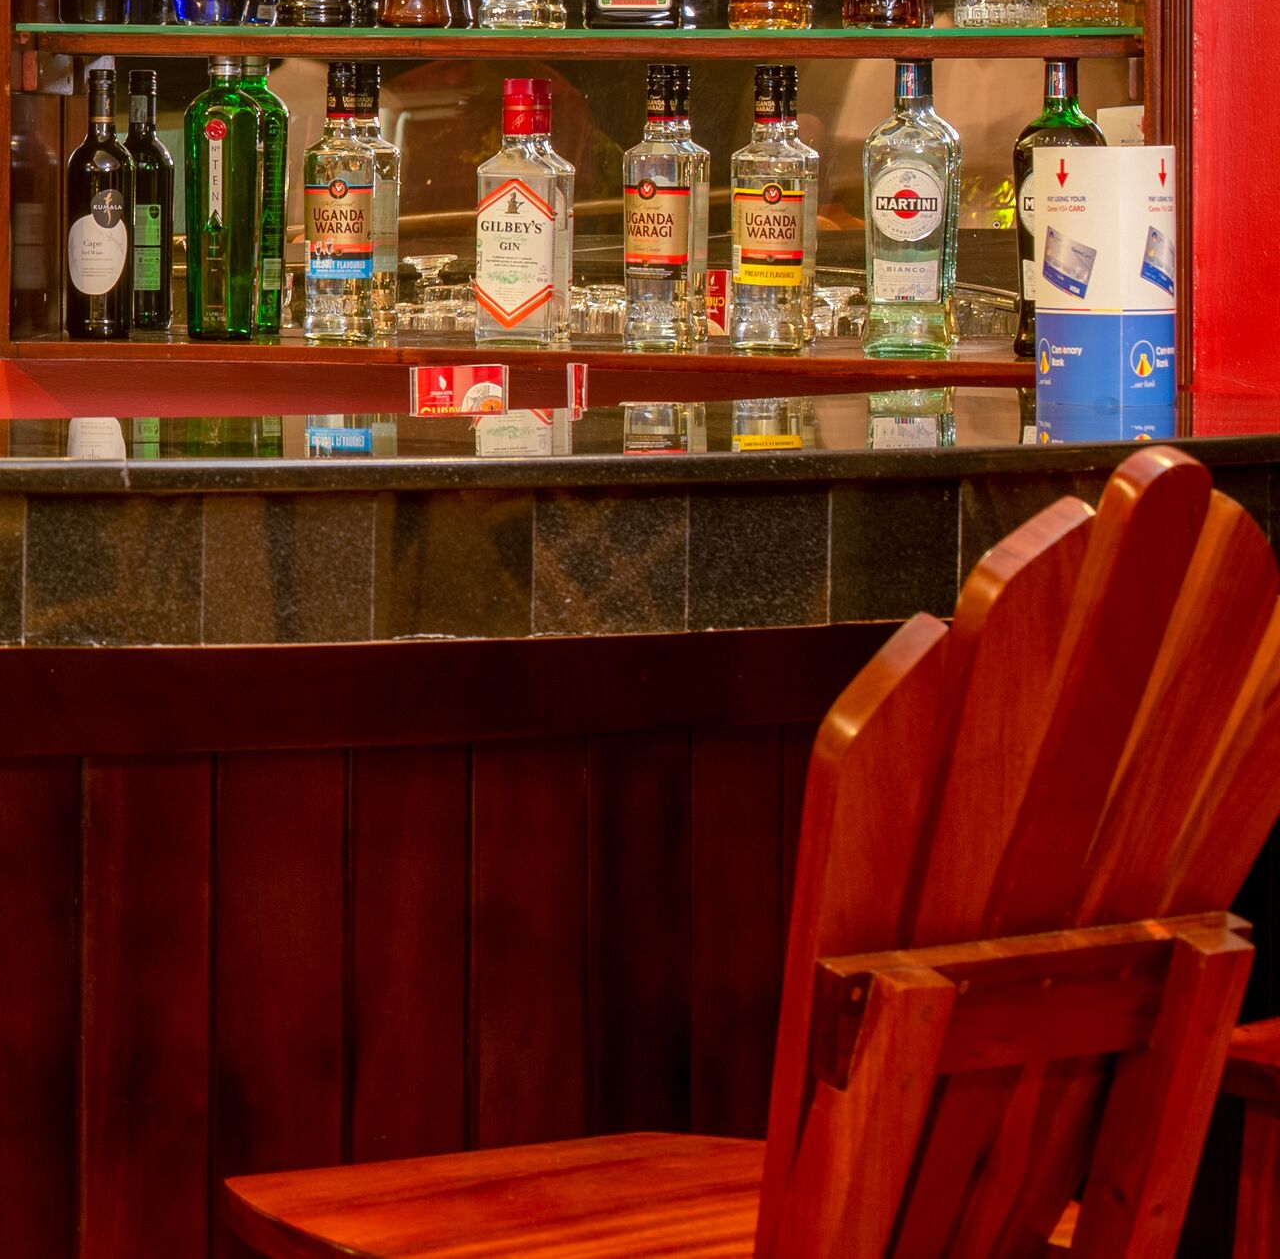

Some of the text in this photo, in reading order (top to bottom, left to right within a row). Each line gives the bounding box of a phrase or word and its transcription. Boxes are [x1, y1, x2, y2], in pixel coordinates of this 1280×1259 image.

[877, 197, 937, 211] MARTINI
[313, 207, 365, 221] UGANDA
[626, 211, 674, 225] UGANDA
[745, 212, 797, 227] UGANDA
[315, 222, 363, 234] WARAGI
[480, 220, 543, 234] GILBEY'S
[627, 225, 673, 238] WARAGI
[747, 227, 796, 239] WARAGI
[83, 239, 103, 249] Cape
[499, 241, 520, 251] GIN
[744, 270, 769, 278] PINEAPPLE
[1051, 357, 1065, 367] Bank
[1155, 358, 1169, 368] Bank
